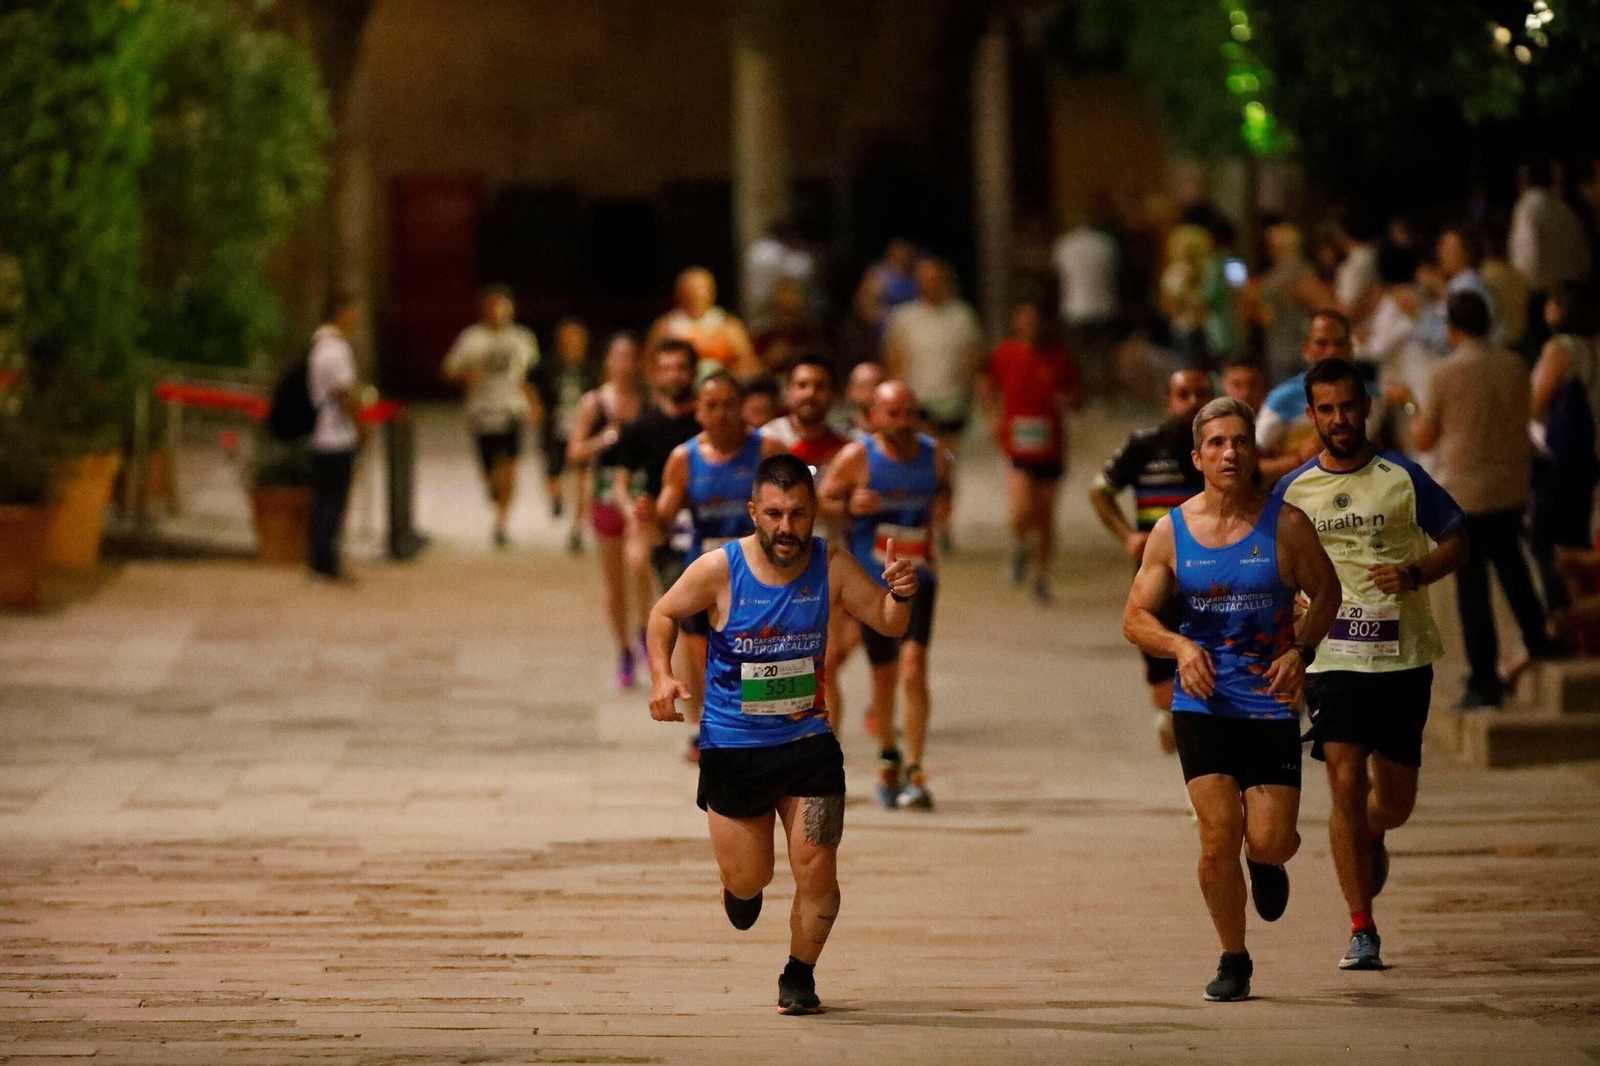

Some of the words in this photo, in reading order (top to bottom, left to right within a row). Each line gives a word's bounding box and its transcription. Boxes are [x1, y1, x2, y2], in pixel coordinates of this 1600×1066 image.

[1312, 513, 1385, 533] arathn
[1190, 595, 1206, 612] 20
[1206, 598, 1273, 612] TROTACALLES
[1349, 607, 1363, 618] 20
[1348, 620, 1381, 637] 802
[733, 637, 753, 654] 20
[753, 635, 786, 646] CARRERA
[786, 632, 822, 643] NOCTURNA
[754, 640, 820, 655] TROTACALLES
[763, 665, 778, 677] 20
[765, 677, 796, 696] 551
